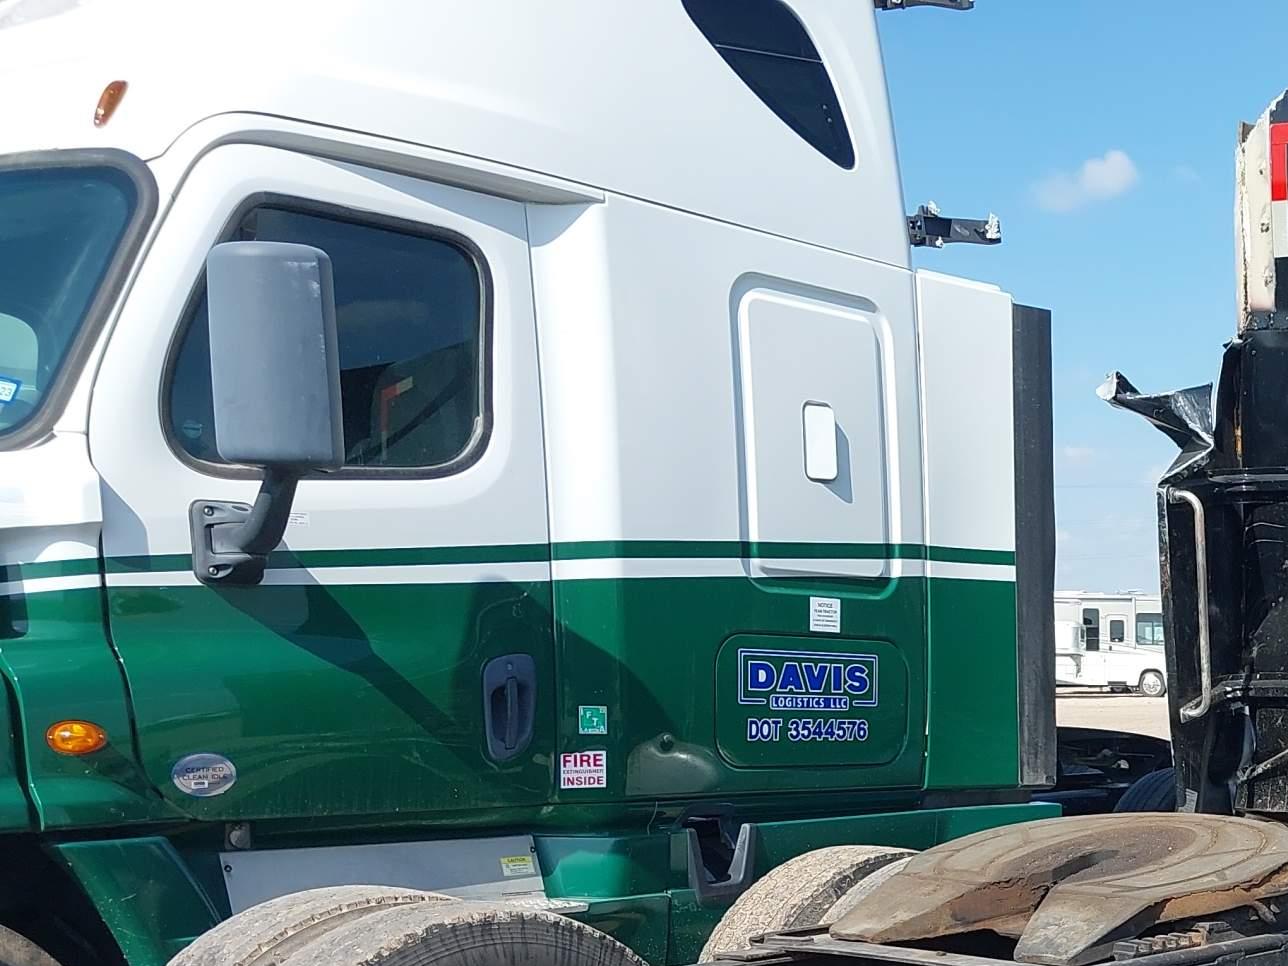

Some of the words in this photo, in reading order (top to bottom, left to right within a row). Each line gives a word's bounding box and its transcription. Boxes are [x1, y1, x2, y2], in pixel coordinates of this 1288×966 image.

[748, 661, 869, 694] DAVIS
[772, 697, 825, 709] LOGISTICS
[830, 698, 847, 709] LLC
[747, 718, 783, 741] DOT
[788, 718, 869, 741] 3544576
[562, 753, 604, 768] FIRE
[185, 766, 225, 774] CERTIFIED
[563, 776, 604, 786] INSIDE
